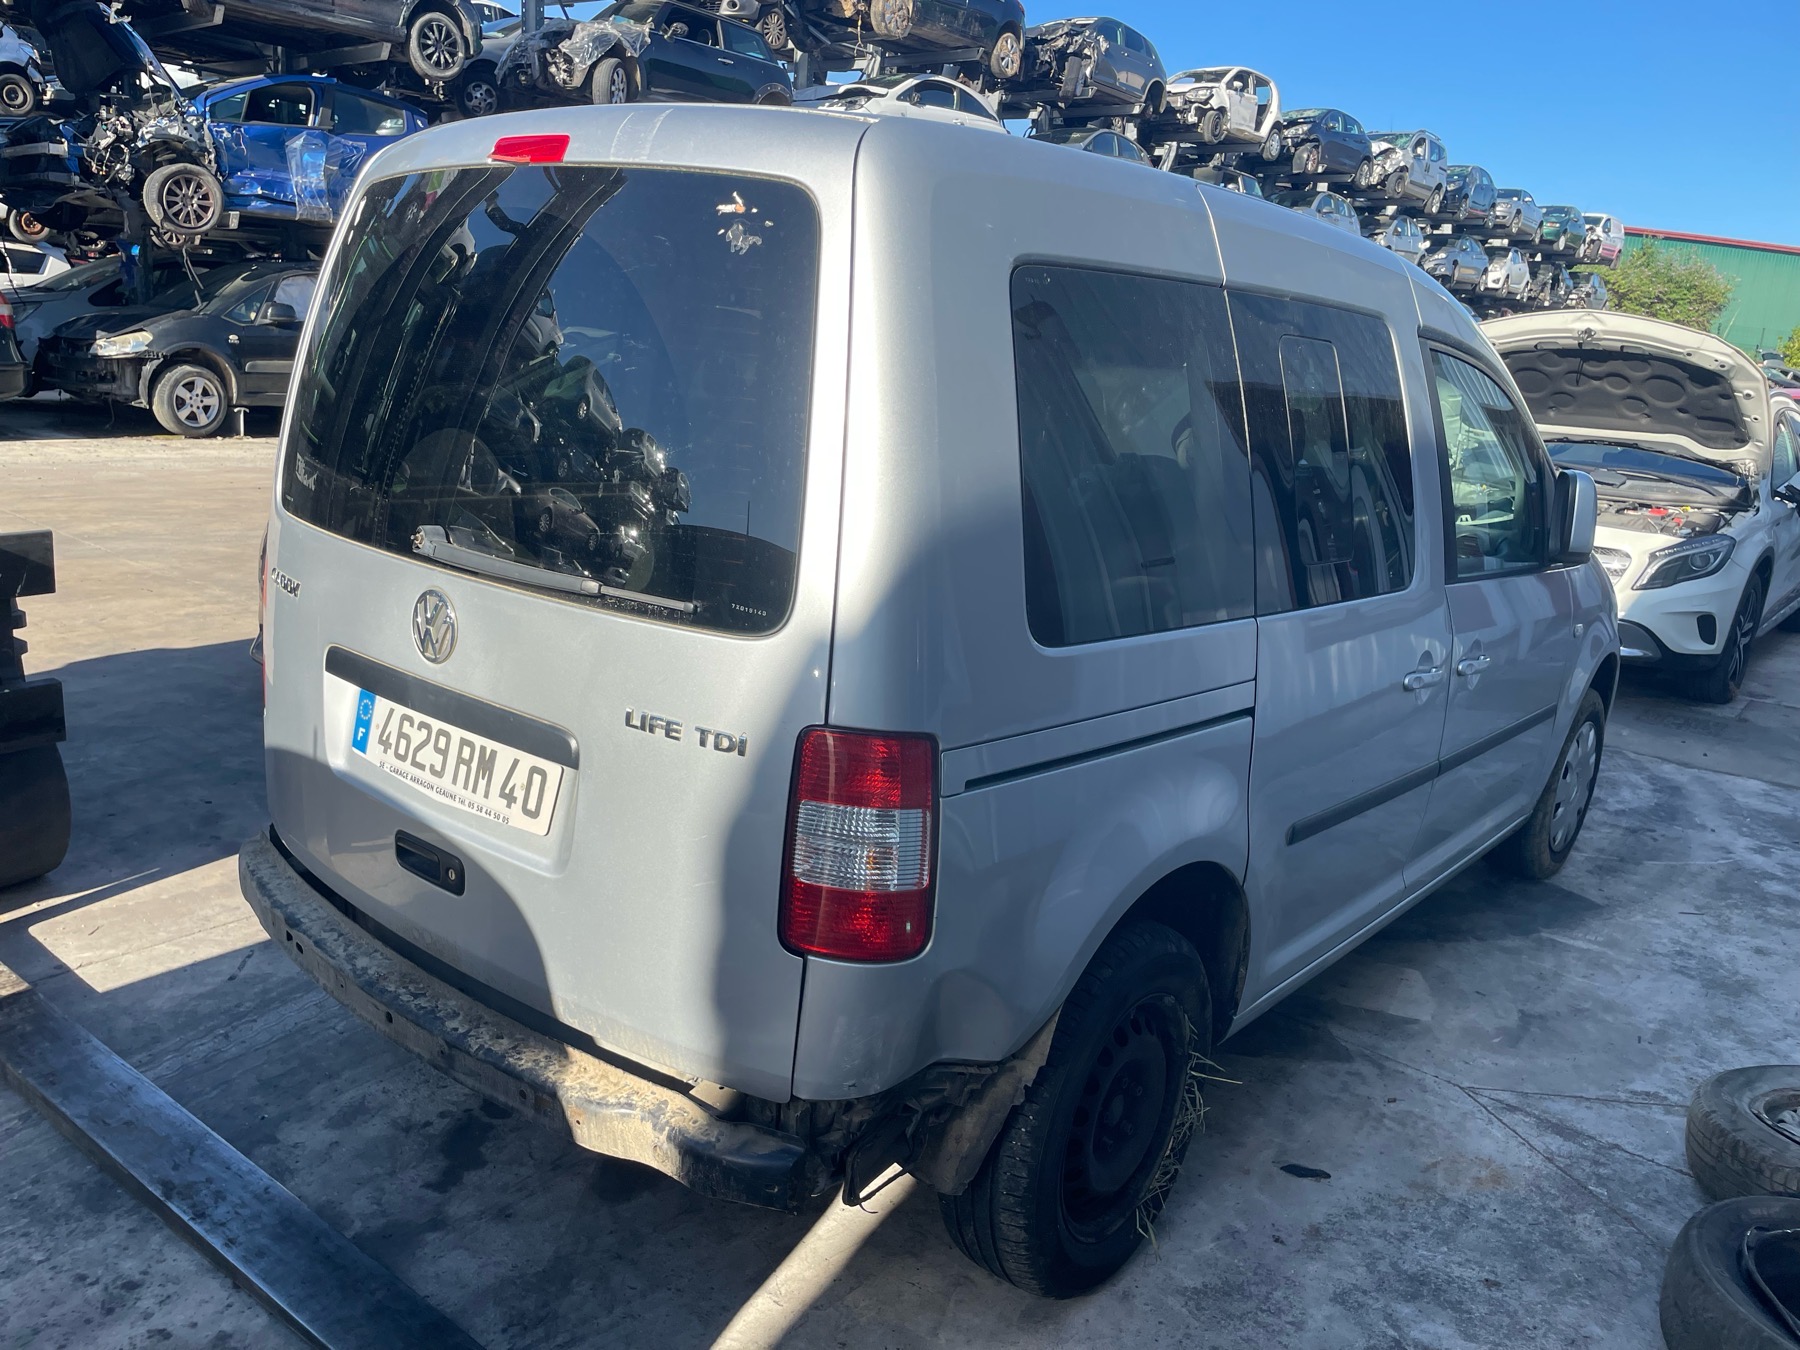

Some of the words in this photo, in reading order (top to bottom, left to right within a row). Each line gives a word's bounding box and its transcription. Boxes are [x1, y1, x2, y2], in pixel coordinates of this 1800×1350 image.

[357, 727, 366, 741] F
[624, 707, 683, 742] LIFE
[377, 707, 452, 779] 4629
[451, 736, 498, 800] RM
[498, 757, 548, 820] 40
[389, 765, 409, 780] GARAGE
[410, 774, 434, 790] ARRAGON
[435, 786, 457, 802] GEAUNE
[467, 801, 475, 810] 05
[484, 808, 492, 817] 44
[493, 812, 501, 821] 50
[501, 815, 510, 825] 05
